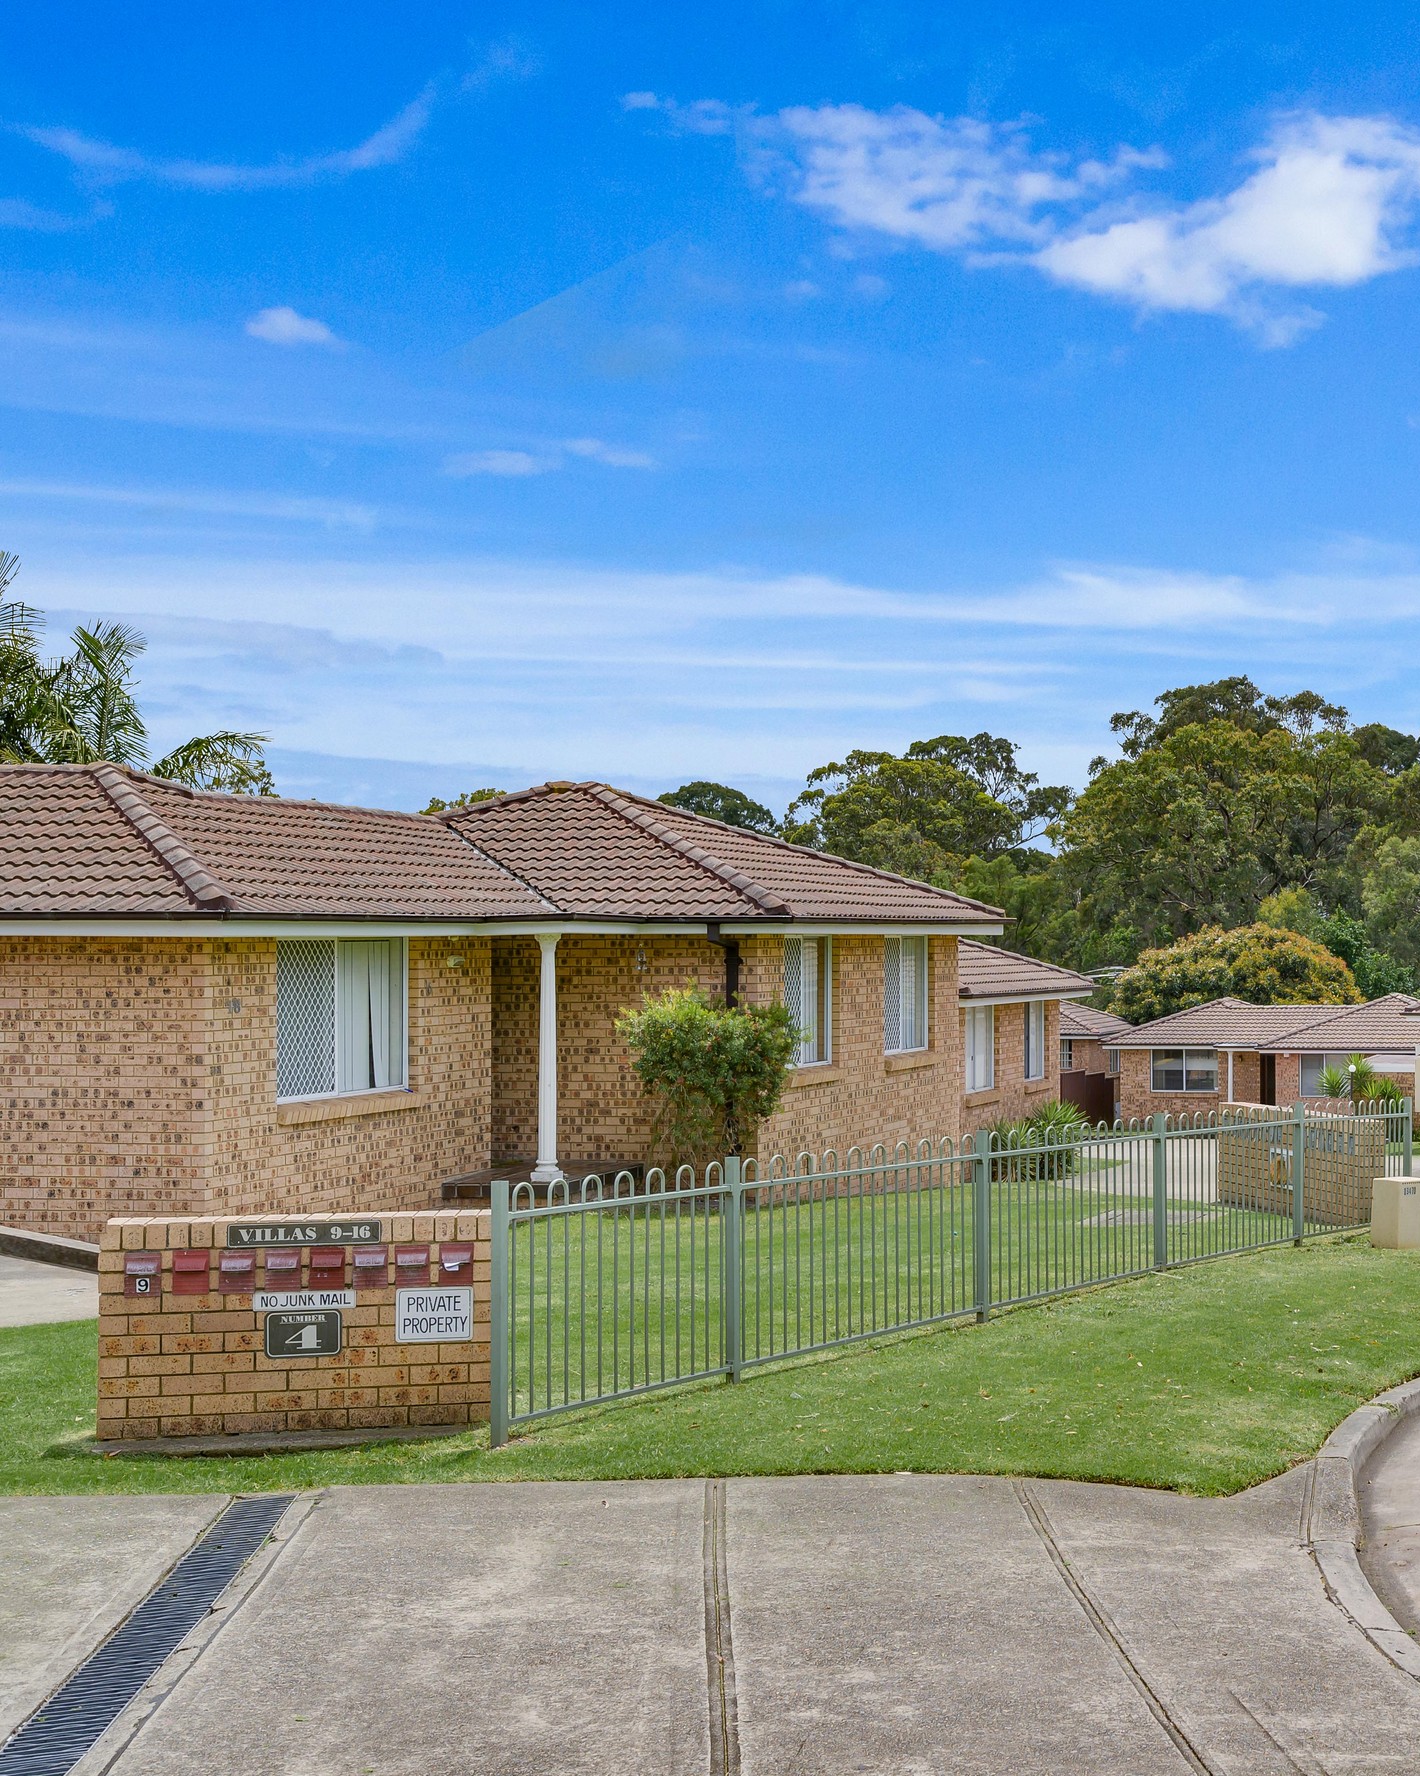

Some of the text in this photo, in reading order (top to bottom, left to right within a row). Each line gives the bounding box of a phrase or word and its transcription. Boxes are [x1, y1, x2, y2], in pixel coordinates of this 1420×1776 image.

[238, 1225, 371, 1242] VILLAS 9-16
[137, 1279, 149, 1292] 9
[260, 1293, 351, 1308] NO JUNK MAIL
[407, 1295, 462, 1313] PRIVATE
[281, 1314, 326, 1323] NUMBER
[403, 1315, 468, 1334] PROPERTY
[284, 1324, 322, 1350] 4
